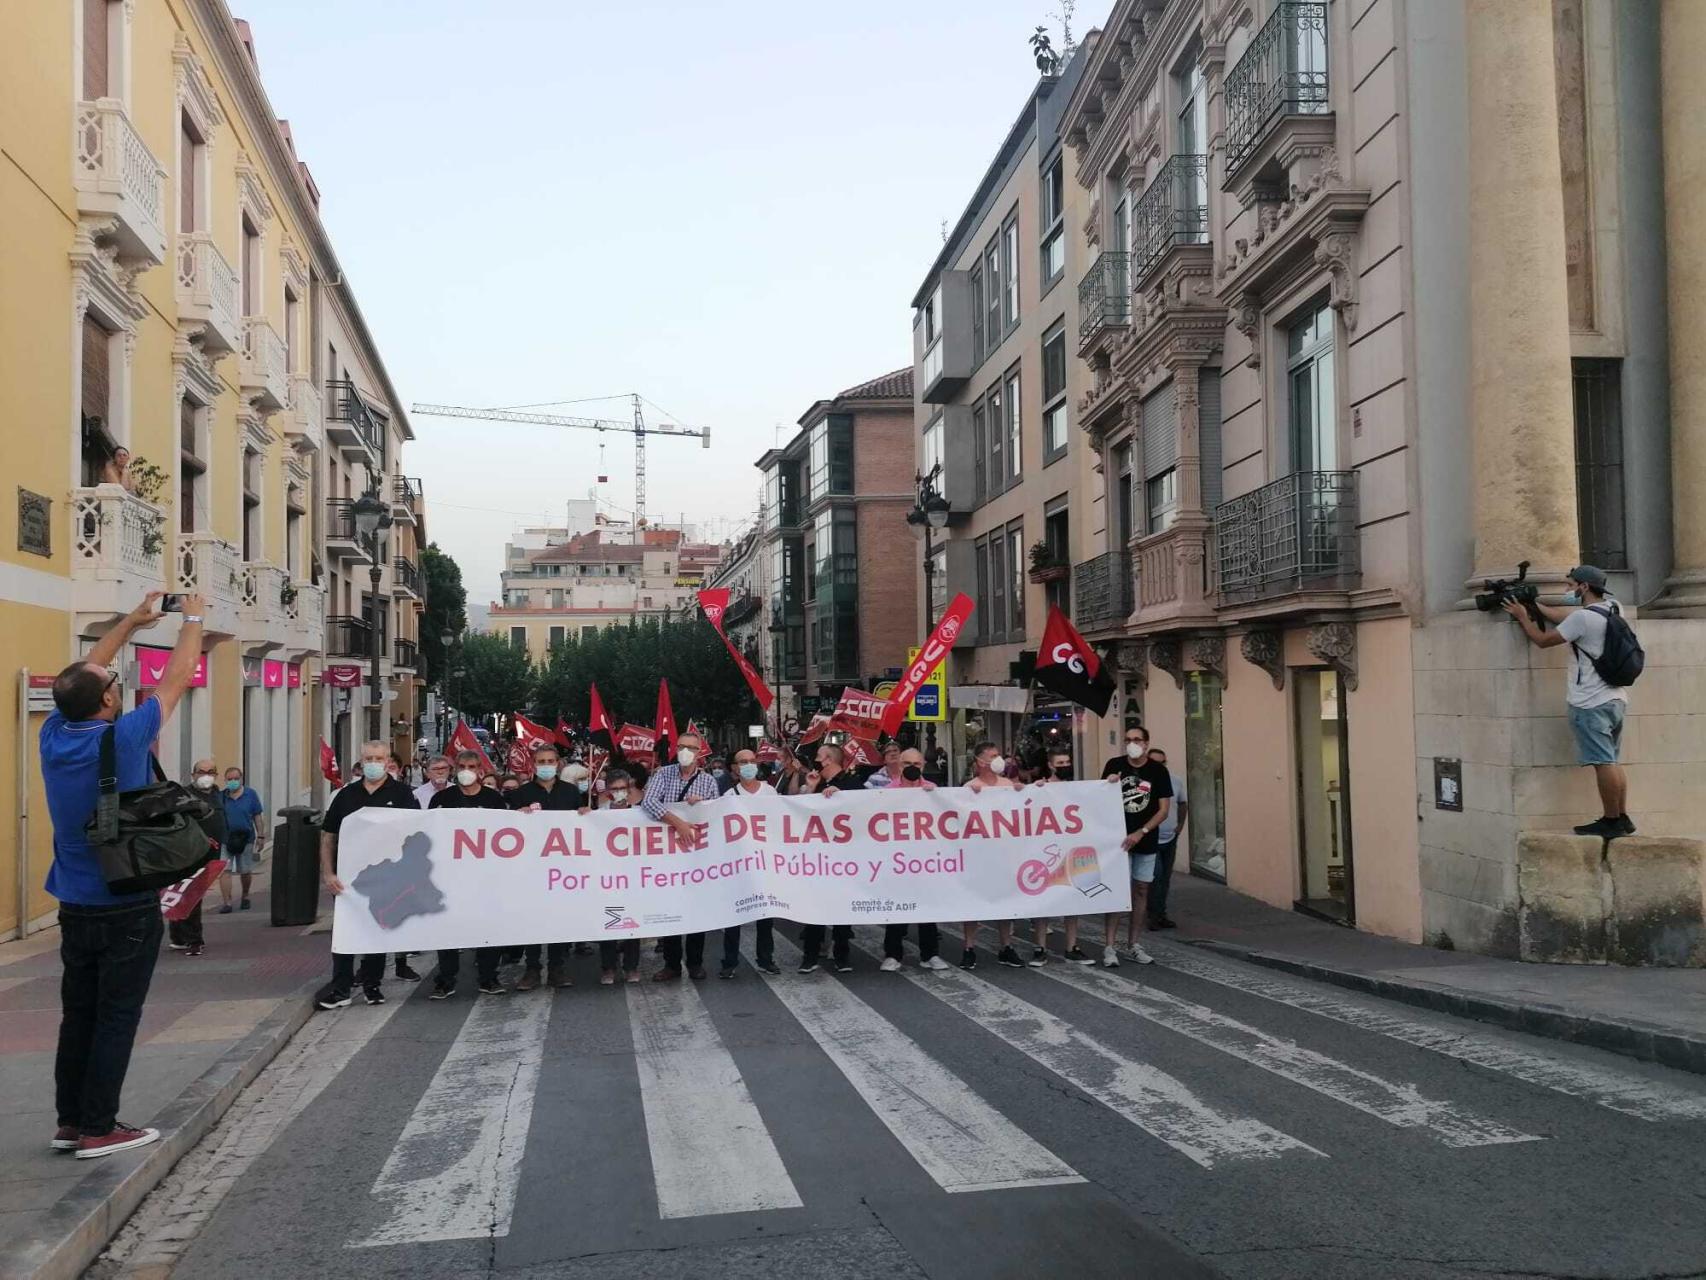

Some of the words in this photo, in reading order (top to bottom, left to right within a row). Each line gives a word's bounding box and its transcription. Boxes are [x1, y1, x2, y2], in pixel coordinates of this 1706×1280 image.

[897, 639, 946, 703] UGT
[453, 828, 525, 860] NO
[541, 827, 591, 858] AL
[723, 813, 767, 843] DE
[783, 814, 854, 845] LAS
[867, 798, 1084, 842] CERCANÍAS
[548, 868, 591, 891] Por
[600, 874, 629, 890] un
[640, 850, 767, 888] Ferrocarril
[773, 852, 859, 878] Público
[868, 860, 883, 882] y
[892, 850, 966, 876] Social
[851, 897, 882, 906] comité
[851, 904, 893, 914] empresa
[895, 902, 918, 912] ADIF
